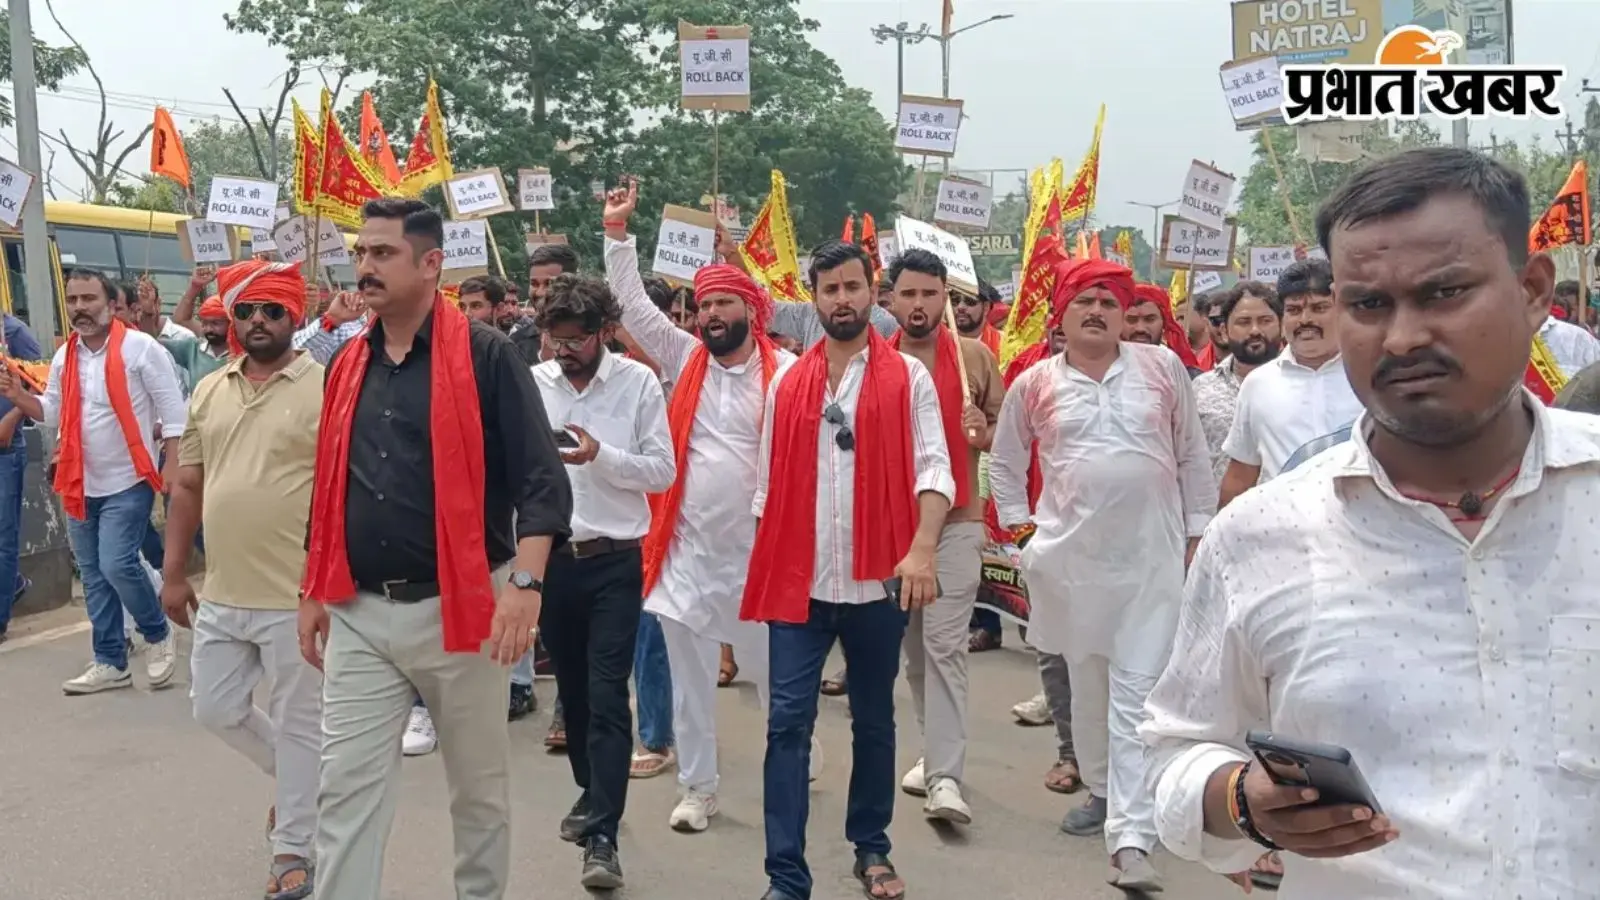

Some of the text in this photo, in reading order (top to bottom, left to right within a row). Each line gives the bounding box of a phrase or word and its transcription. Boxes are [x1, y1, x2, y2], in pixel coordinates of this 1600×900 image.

[1259, 0, 1356, 25] HOTEL
[1250, 19, 1367, 53] NATRAJ
[685, 71, 744, 82] ROLL BACK
[1231, 86, 1280, 108] ROLL BACK
[900, 127, 951, 141] ROLL BACK
[458, 191, 498, 206] ROLL BACK
[1183, 194, 1223, 217] ROLL BACK
[211, 203, 270, 217] ROLL BACK
[938, 202, 987, 217] ROLL BACK
[197, 243, 224, 253] GO BACK
[443, 246, 482, 259] OLL BACK
[1174, 246, 1220, 257] GO BACK
[658, 248, 706, 269] ROLL BACK
[1256, 268, 1270, 276] GO
